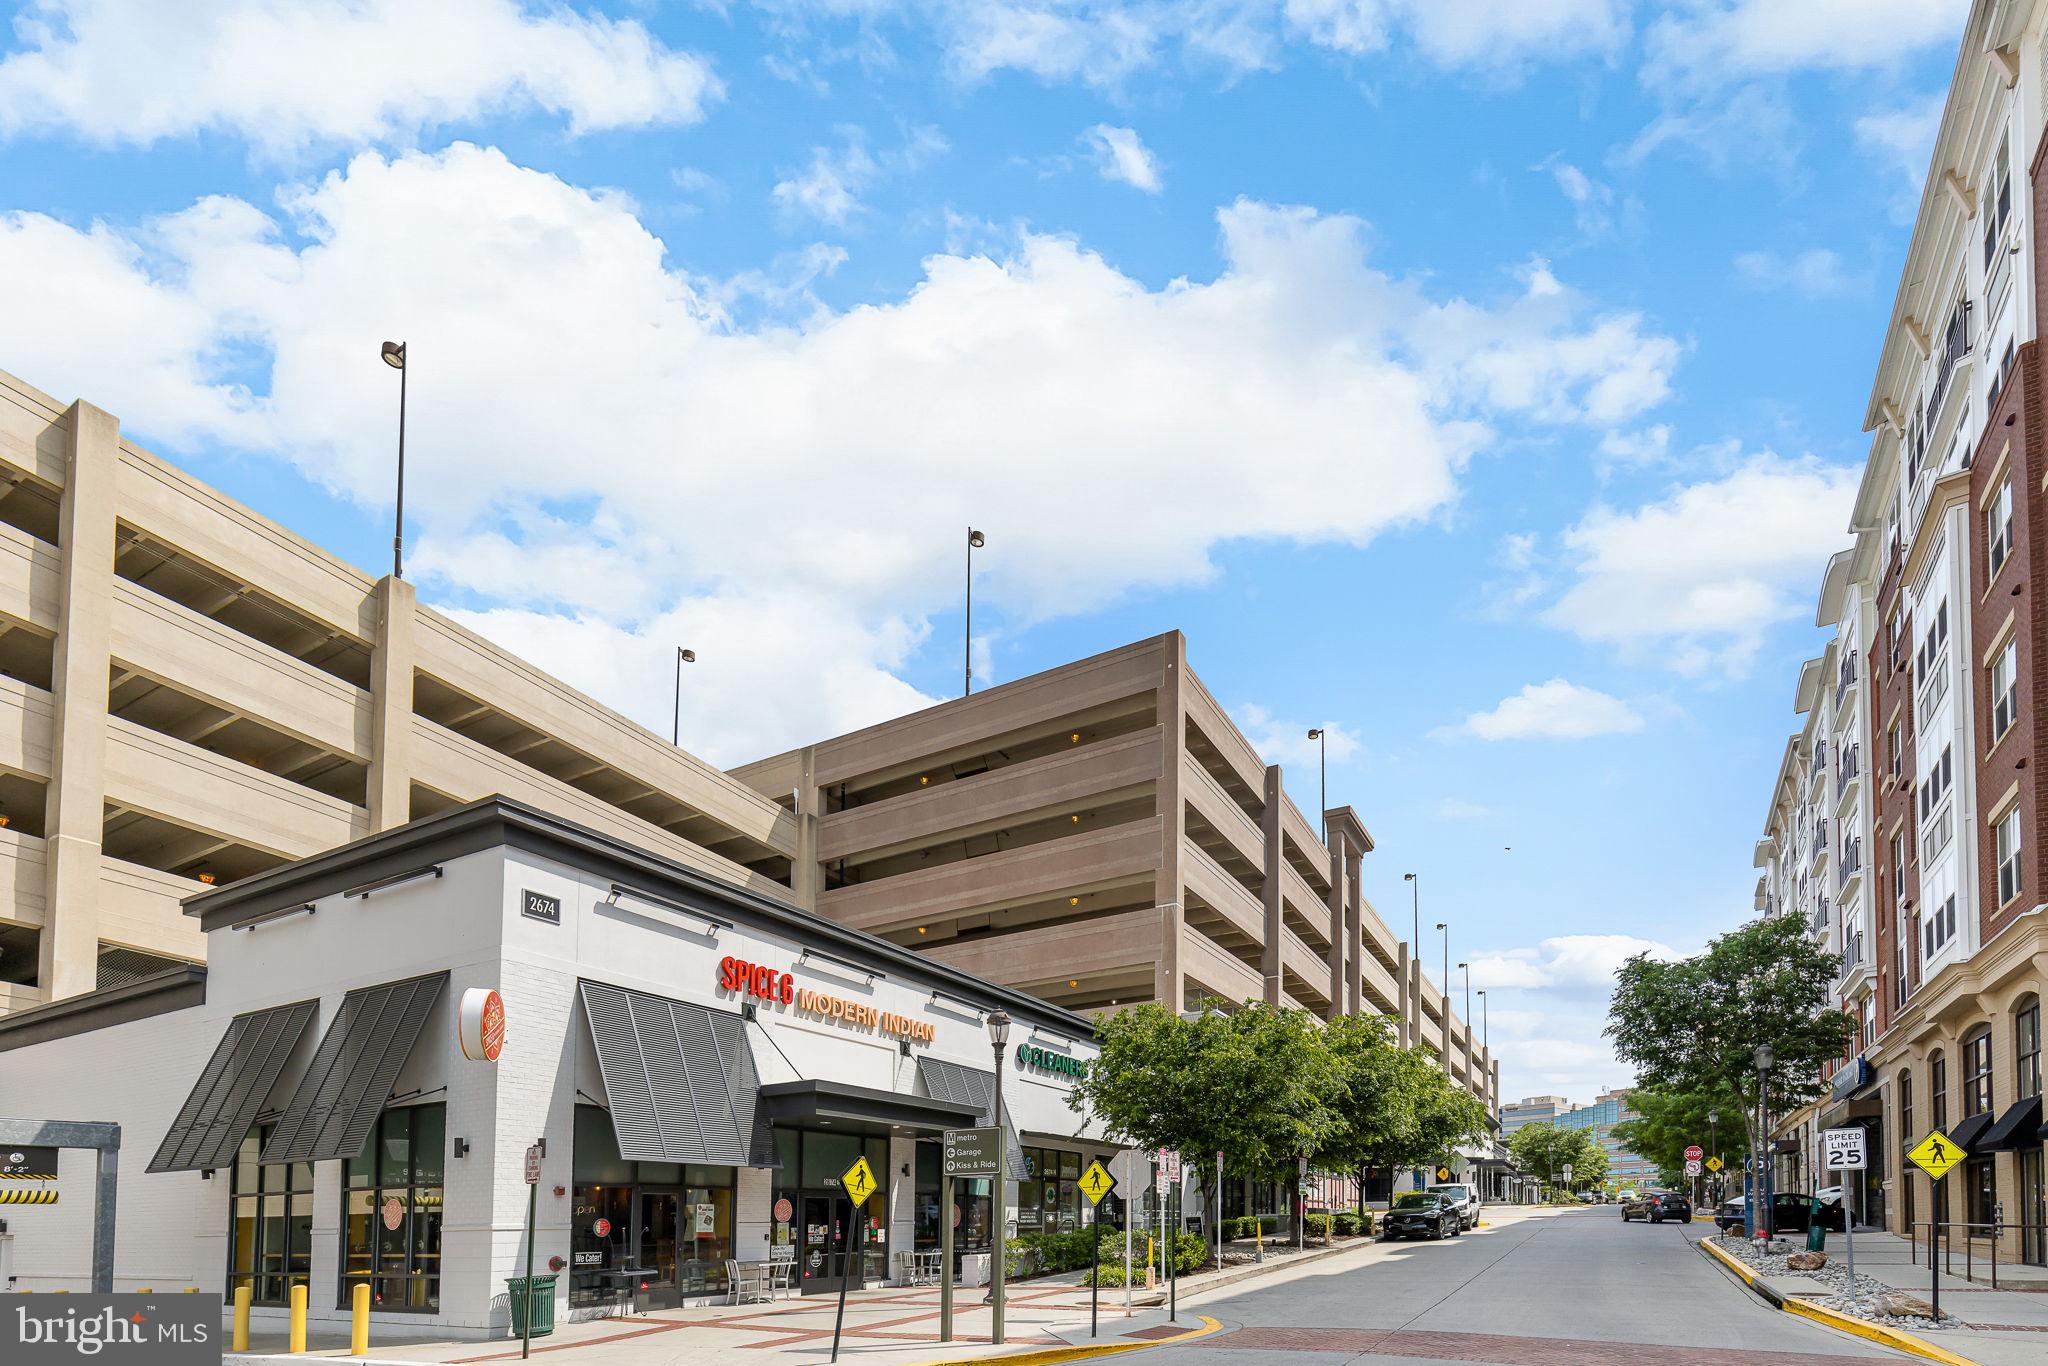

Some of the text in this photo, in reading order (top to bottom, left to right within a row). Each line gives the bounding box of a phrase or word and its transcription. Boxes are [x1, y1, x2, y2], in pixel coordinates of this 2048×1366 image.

[530, 896, 555, 916] 2674
[720, 955, 794, 1005] SPICE 6
[798, 987, 936, 1042] MODERN INDIAN
[1032, 1047, 1089, 1079] CLEANERS
[1827, 1132, 1862, 1141] SPEED
[956, 1148, 982, 1156] Garage
[1829, 1150, 1862, 1166] 25
[575, 1252, 602, 1262] We Cater!
